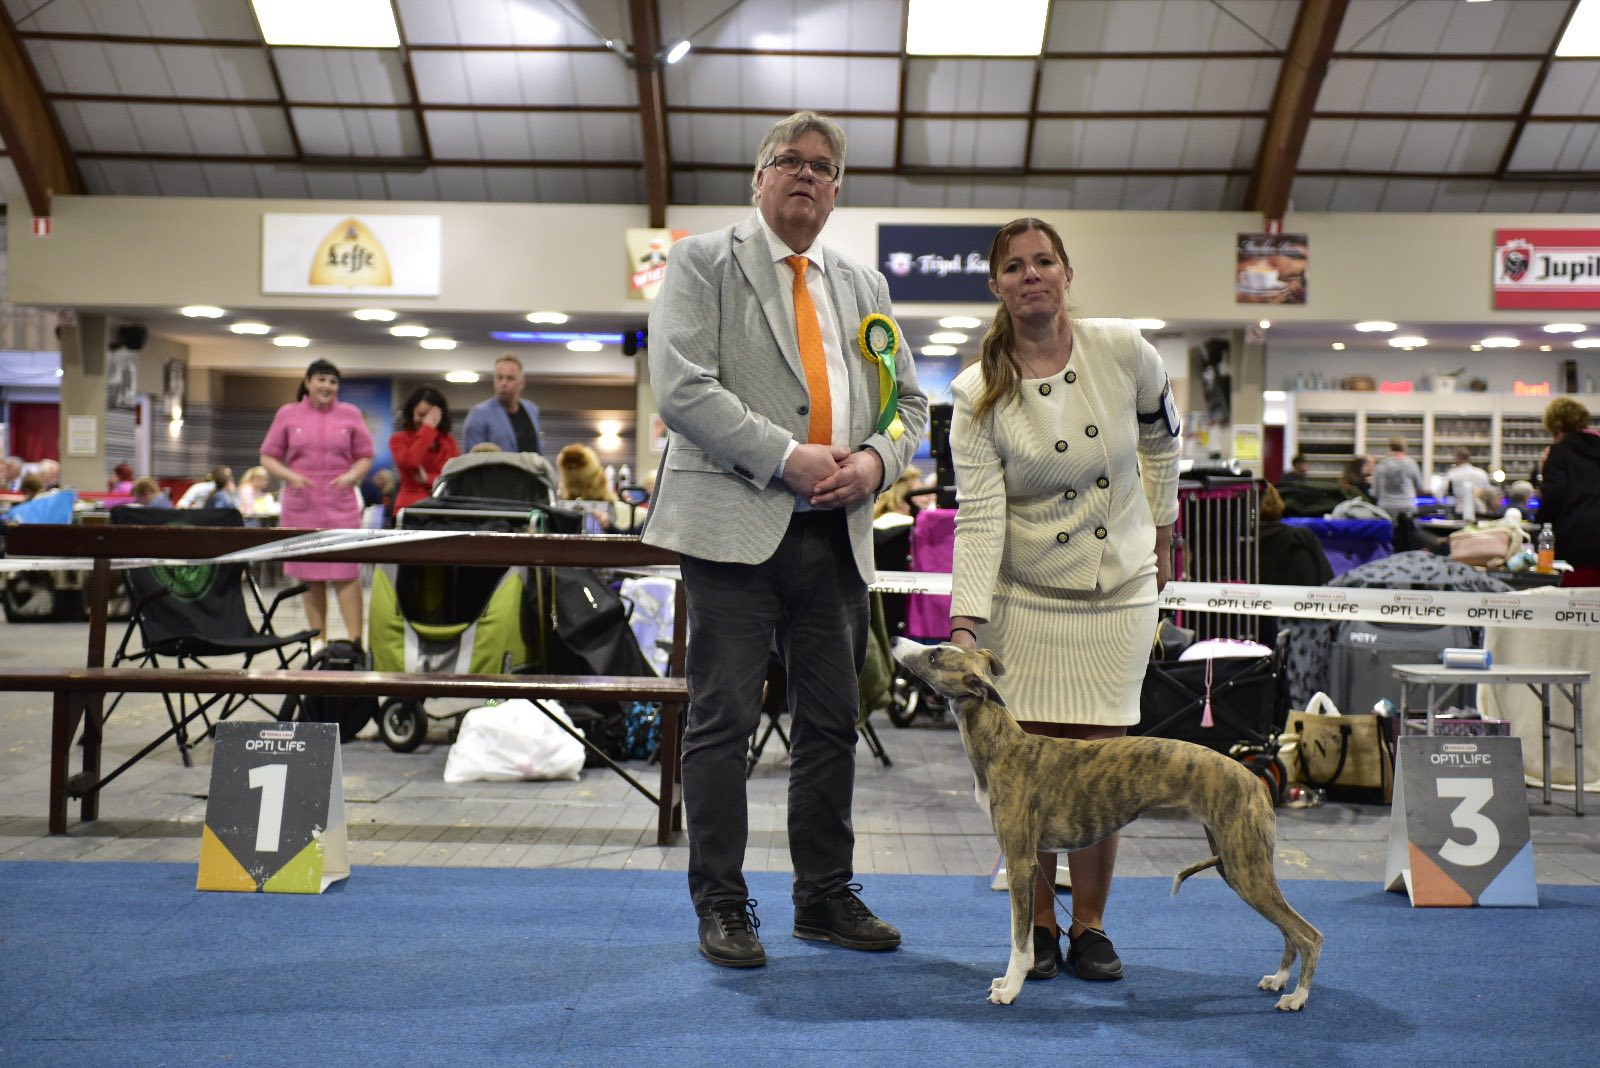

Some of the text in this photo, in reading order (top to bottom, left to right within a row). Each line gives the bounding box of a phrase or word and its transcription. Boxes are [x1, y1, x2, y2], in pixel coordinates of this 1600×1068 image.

[327, 244, 375, 272] Leffe
[1207, 598, 1273, 610] OPTI LIFE
[1294, 601, 1359, 614] OPTI LIFE
[1380, 605, 1446, 617] OPTI LIFE
[1467, 608, 1533, 620] OPTI LIFE
[1555, 611, 1586, 622] OPTI
[245, 739, 306, 751] OPTI LIFE
[1430, 753, 1492, 765] OPTI LIFE
[248, 763, 288, 852] 1
[1436, 777, 1500, 867] 3
